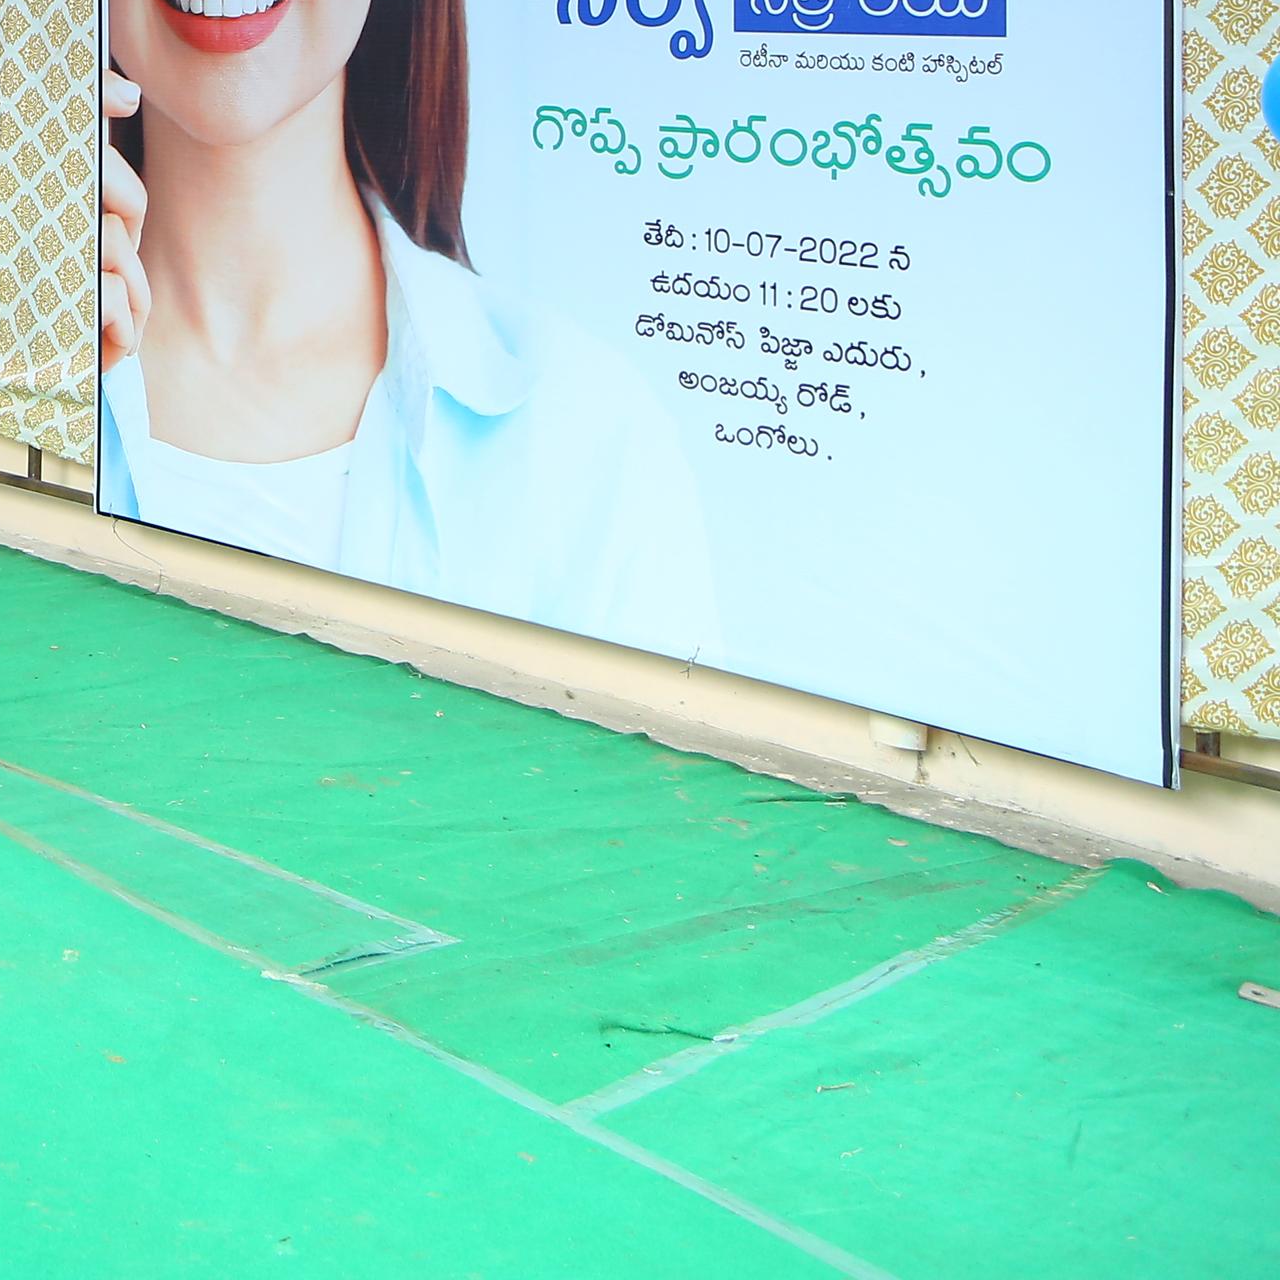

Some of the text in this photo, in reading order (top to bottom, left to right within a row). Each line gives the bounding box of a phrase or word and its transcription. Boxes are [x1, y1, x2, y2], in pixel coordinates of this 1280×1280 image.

[739, 43, 1004, 83] రెటీనా మరియు కంటి హాస్పిటల్
[532, 105, 1053, 198] గొప్ప ప్రారంభోత్సవం
[704, 227, 880, 269] 10-07-2022
[888, 245, 911, 271] న
[650, 270, 751, 302] ఉదయం
[847, 294, 902, 320] లకు
[635, 313, 746, 349] డోమినోస్
[759, 326, 814, 371] పిజ్జా
[678, 370, 789, 415] అంజయ్య
